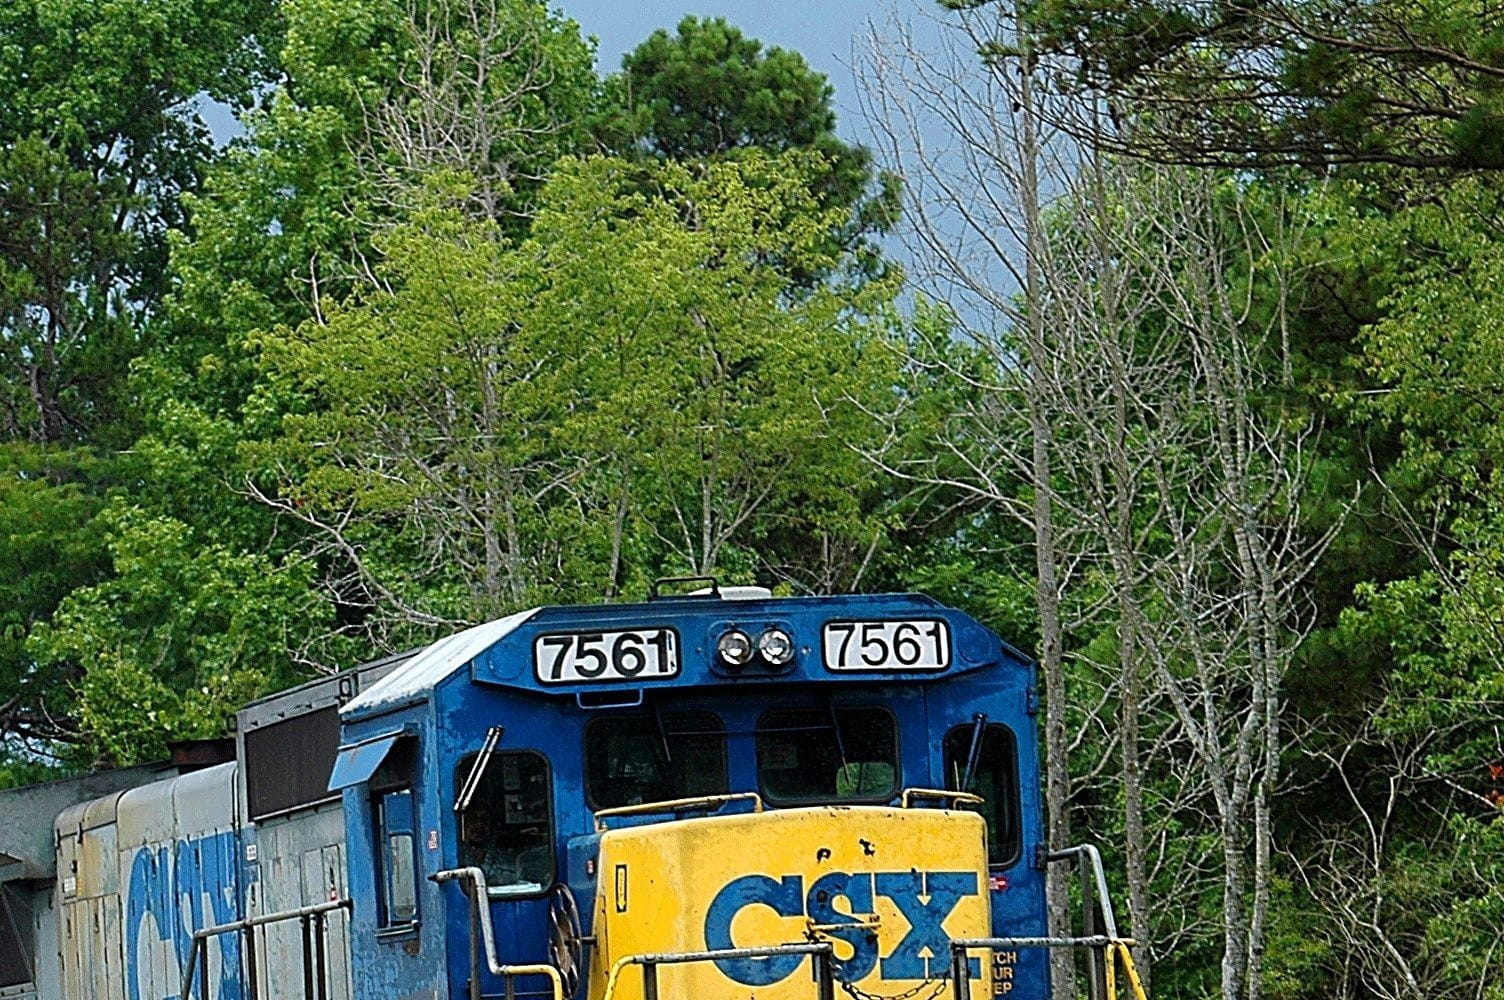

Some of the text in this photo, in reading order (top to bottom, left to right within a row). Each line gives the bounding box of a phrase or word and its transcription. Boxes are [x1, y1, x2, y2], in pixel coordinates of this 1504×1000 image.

[543, 629, 669, 680] 7561
[829, 622, 943, 667] 7561
[704, 871, 982, 987] CSX
[992, 951, 1016, 965] TCH
[994, 966, 1013, 980] UR
[995, 982, 1013, 995] EP
